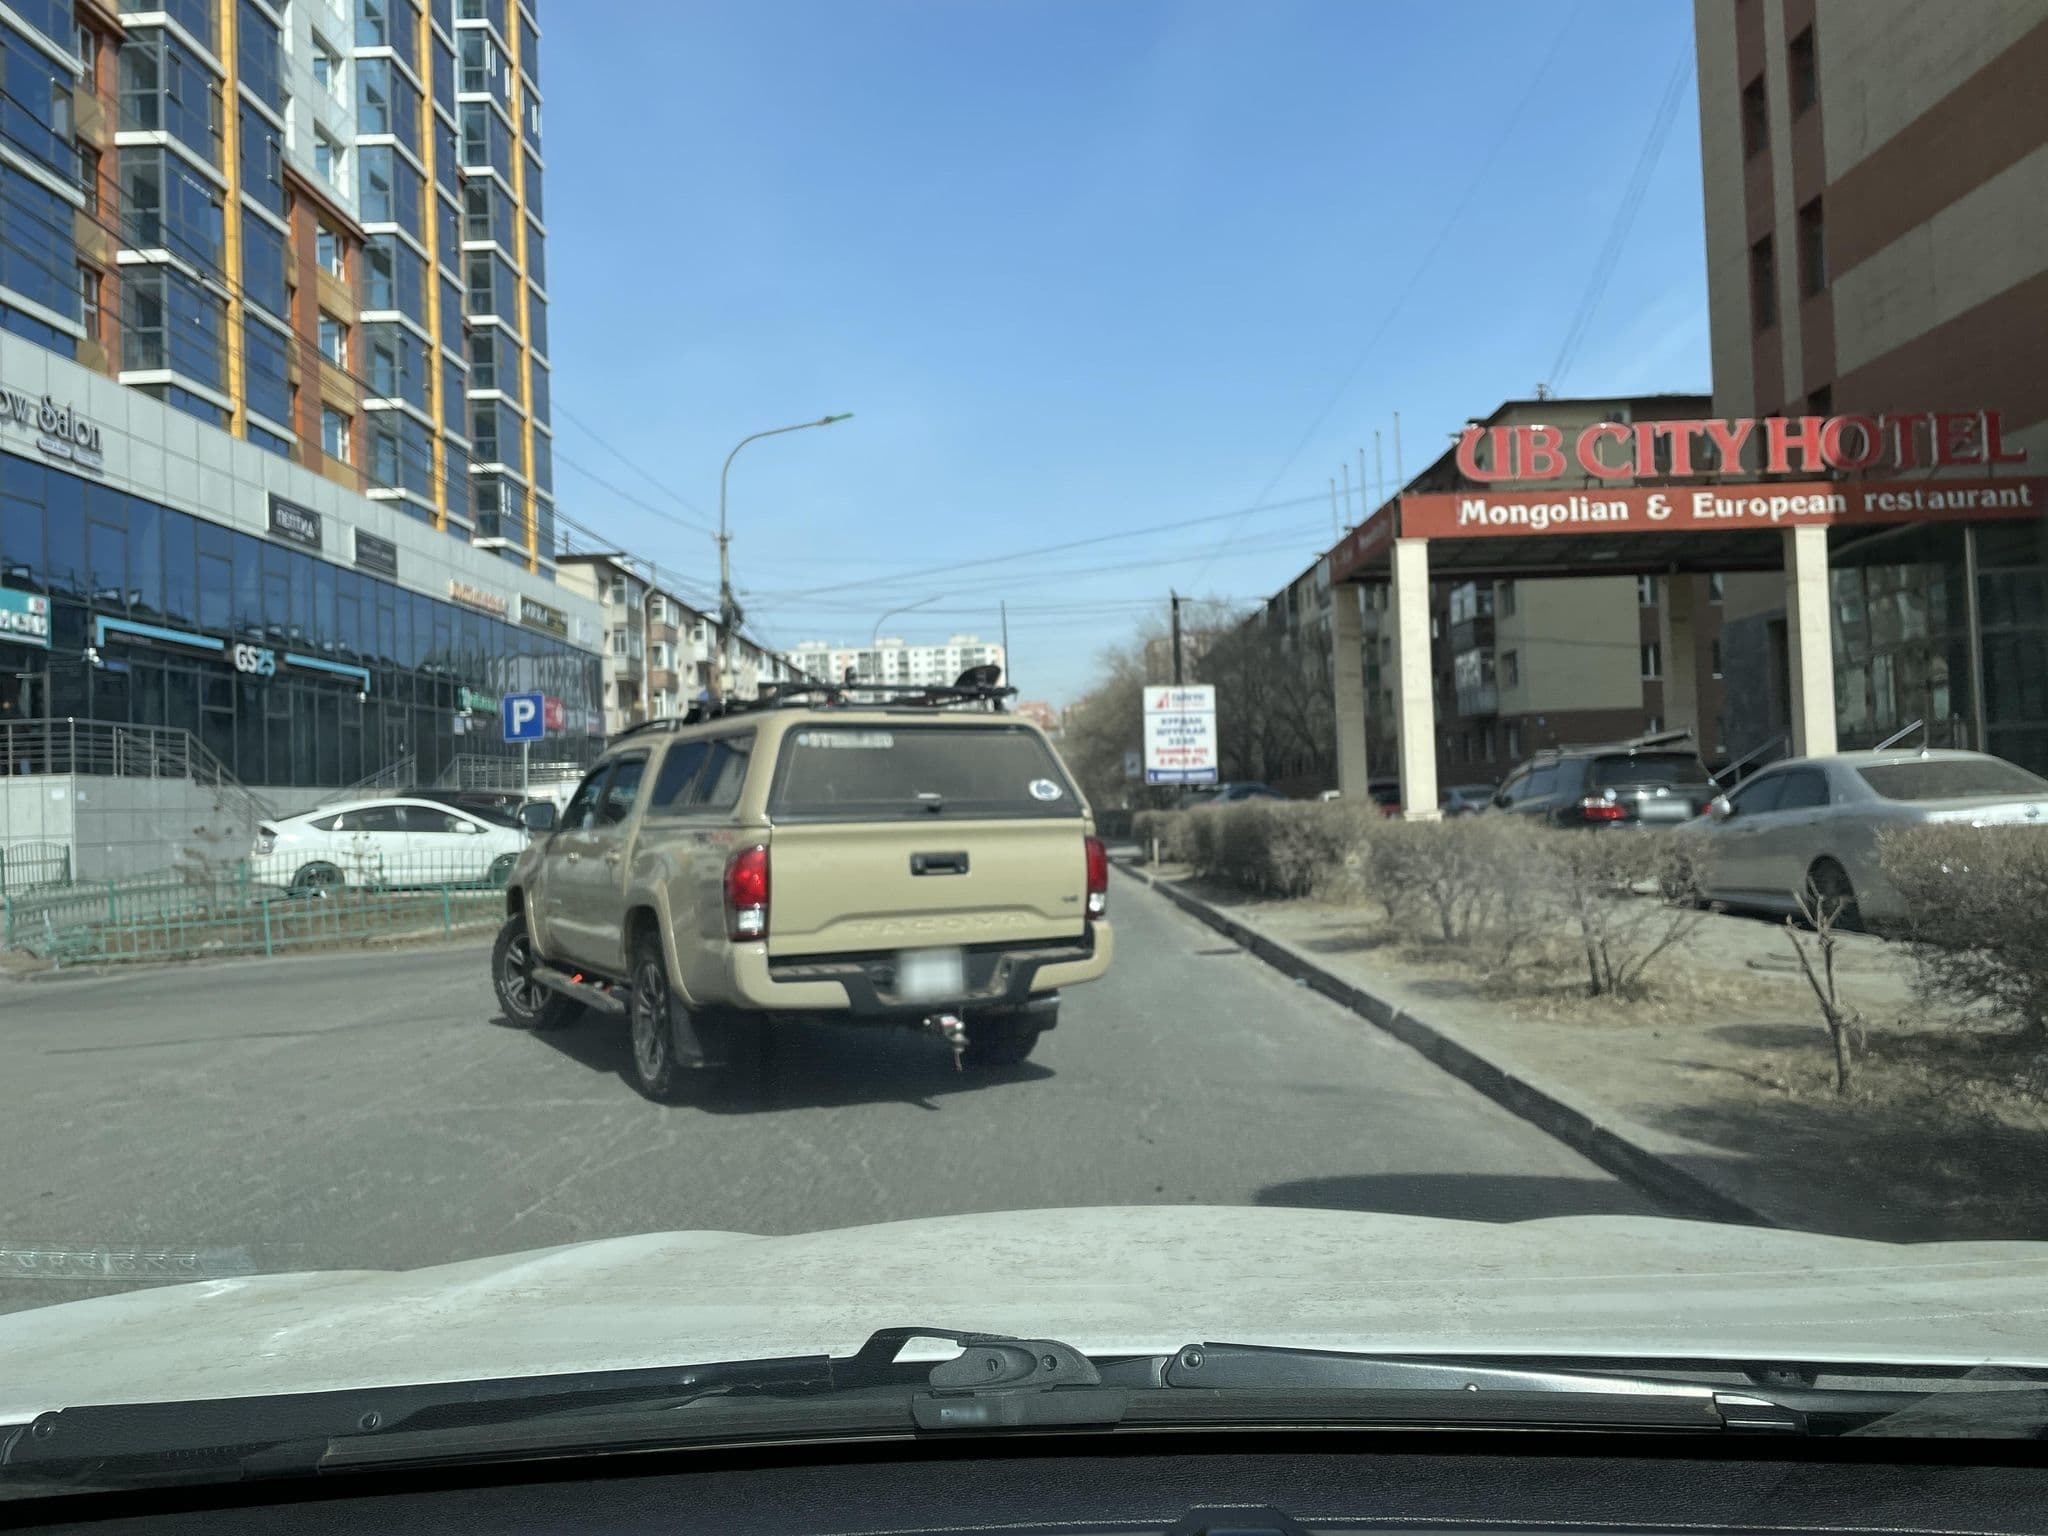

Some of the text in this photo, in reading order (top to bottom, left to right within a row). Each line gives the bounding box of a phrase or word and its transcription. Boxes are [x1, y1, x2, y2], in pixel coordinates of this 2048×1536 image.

[38, 395, 101, 451] Salon
[1456, 409, 2028, 482] UB CITY HOTEL
[1459, 483, 2033, 529] Mongolian & European restaurant
[233, 643, 277, 677] GS25
[513, 699, 536, 735] P
